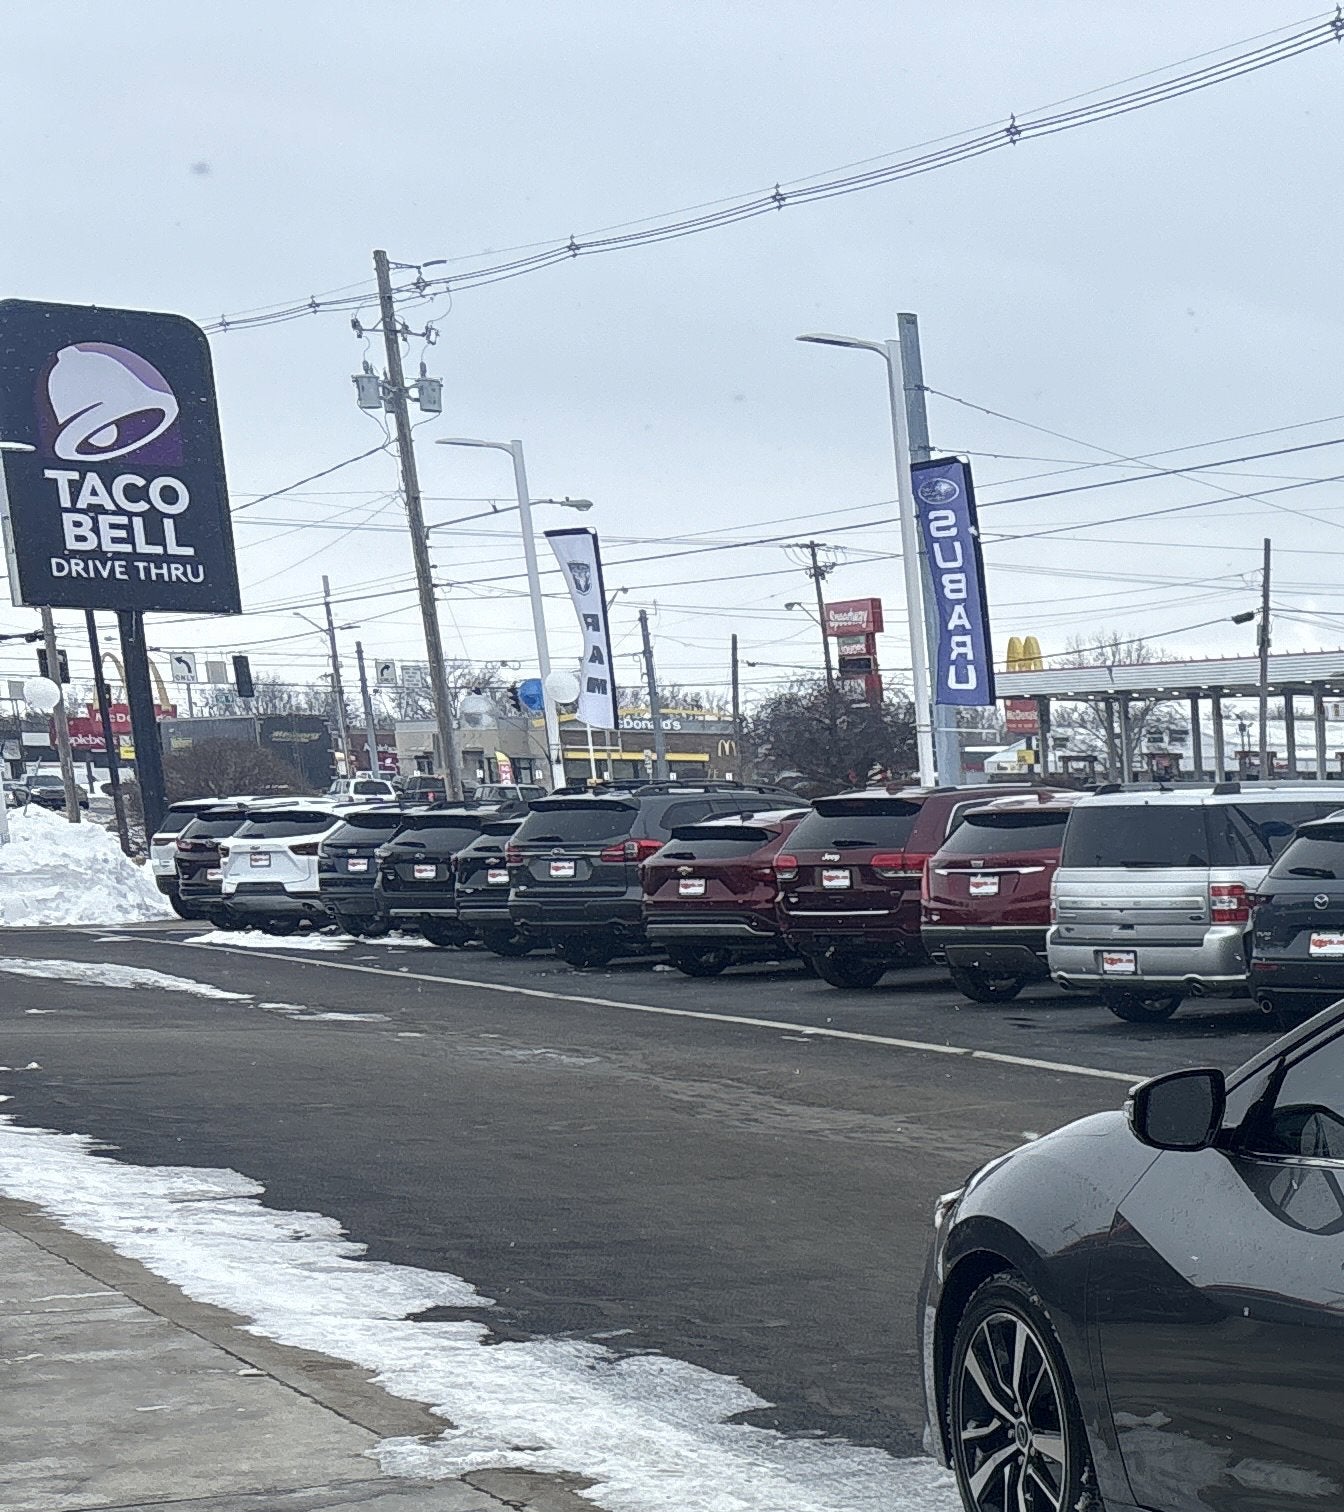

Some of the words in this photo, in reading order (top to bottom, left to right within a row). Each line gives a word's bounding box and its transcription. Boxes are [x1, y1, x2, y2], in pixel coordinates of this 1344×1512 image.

[43, 469, 190, 515] TACO
[61, 512, 195, 556] BELL
[50, 557, 129, 581] DRIVE
[134, 561, 205, 583] THRU
[174, 674, 196, 682] ONLY
[822, 853, 840, 862] Jeep
